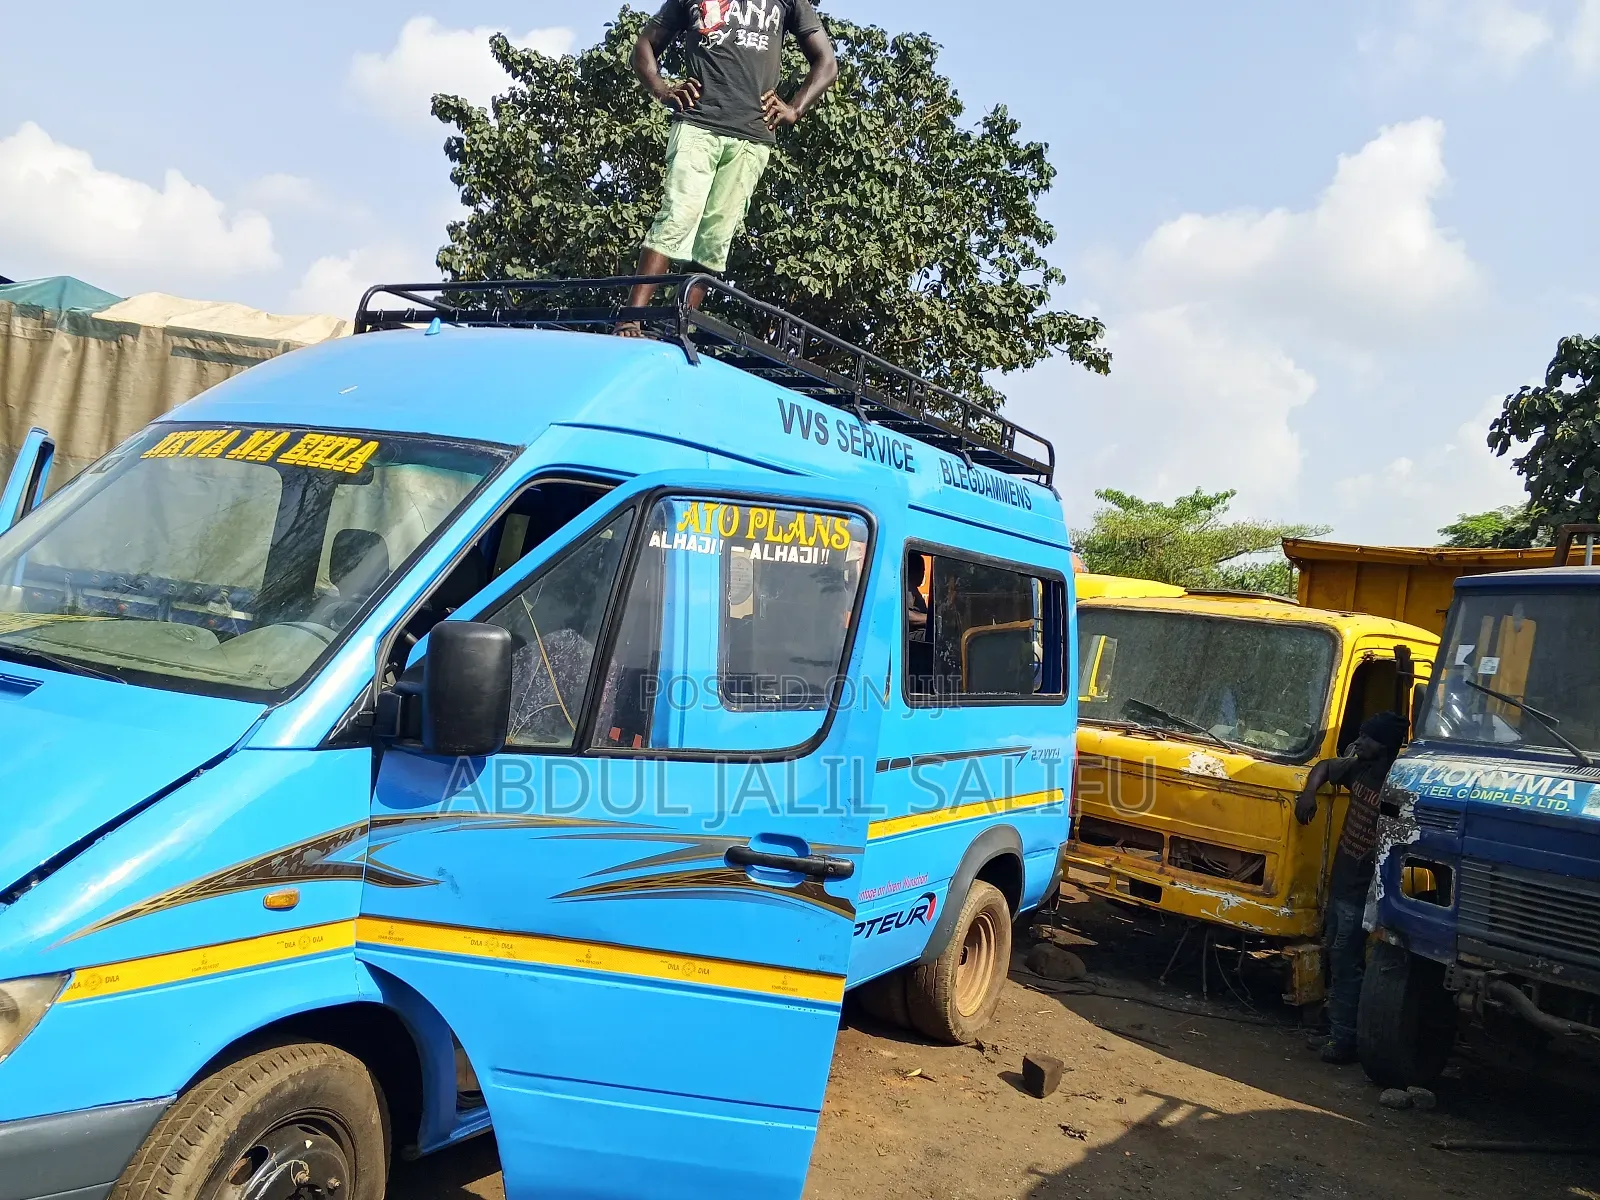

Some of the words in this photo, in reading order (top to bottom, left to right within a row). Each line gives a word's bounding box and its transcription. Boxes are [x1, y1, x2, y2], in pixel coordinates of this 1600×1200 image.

[225, 430, 291, 462] NA
[777, 397, 829, 445] VVS
[835, 419, 915, 474] SERVICE
[938, 456, 1032, 511] BLEGDAMMENS
[676, 500, 740, 538] ATO
[745, 506, 852, 550] PLANS
[1416, 784, 1454, 799] STEEL
[1456, 787, 1532, 806] COMPLEX
[1536, 798, 1570, 812] LTD.
[1420, 764, 1576, 801] DONYMA
